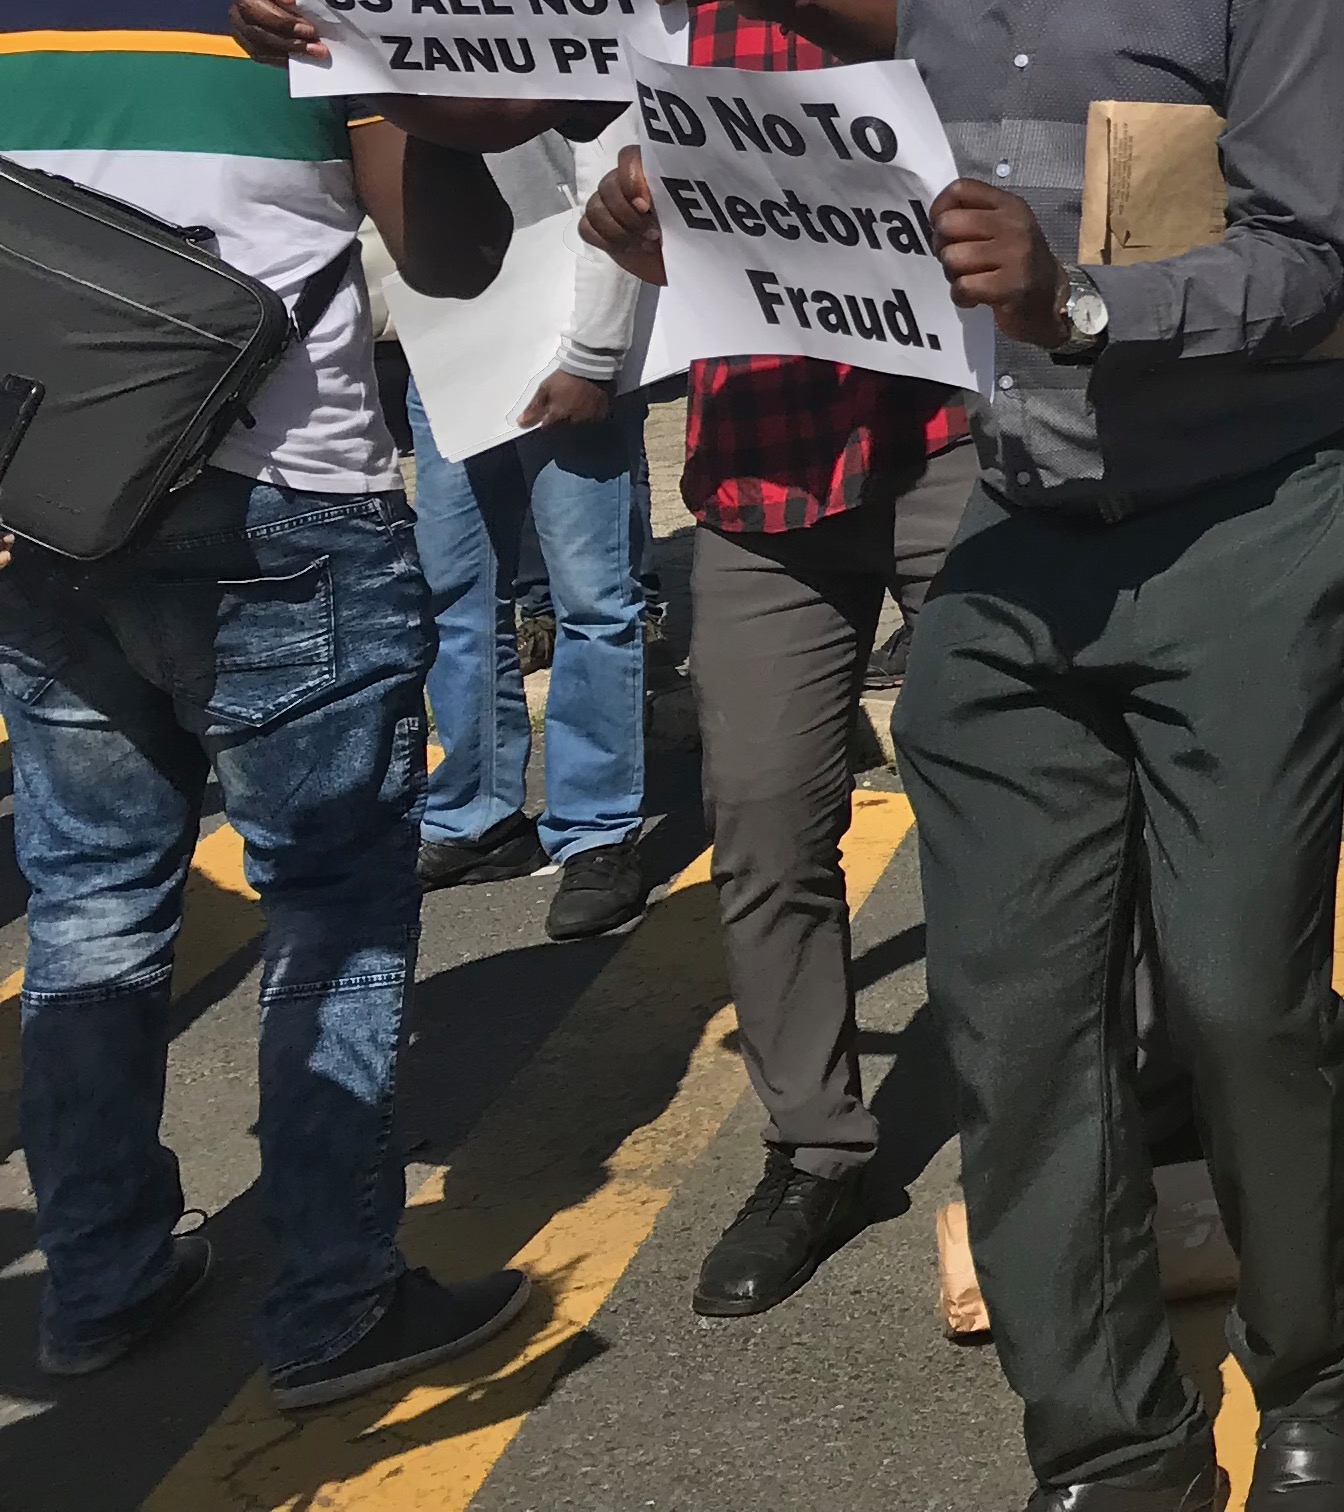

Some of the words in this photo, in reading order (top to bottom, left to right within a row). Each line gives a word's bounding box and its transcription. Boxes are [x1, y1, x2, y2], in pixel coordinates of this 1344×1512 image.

[382, 35, 537, 74] ZANU
[549, 37, 620, 75] PF
[636, 79, 707, 147] ED
[706, 96, 806, 157] No
[800, 102, 898, 163] To
[661, 176, 934, 256] Electoral
[745, 268, 942, 352] Fraud.
